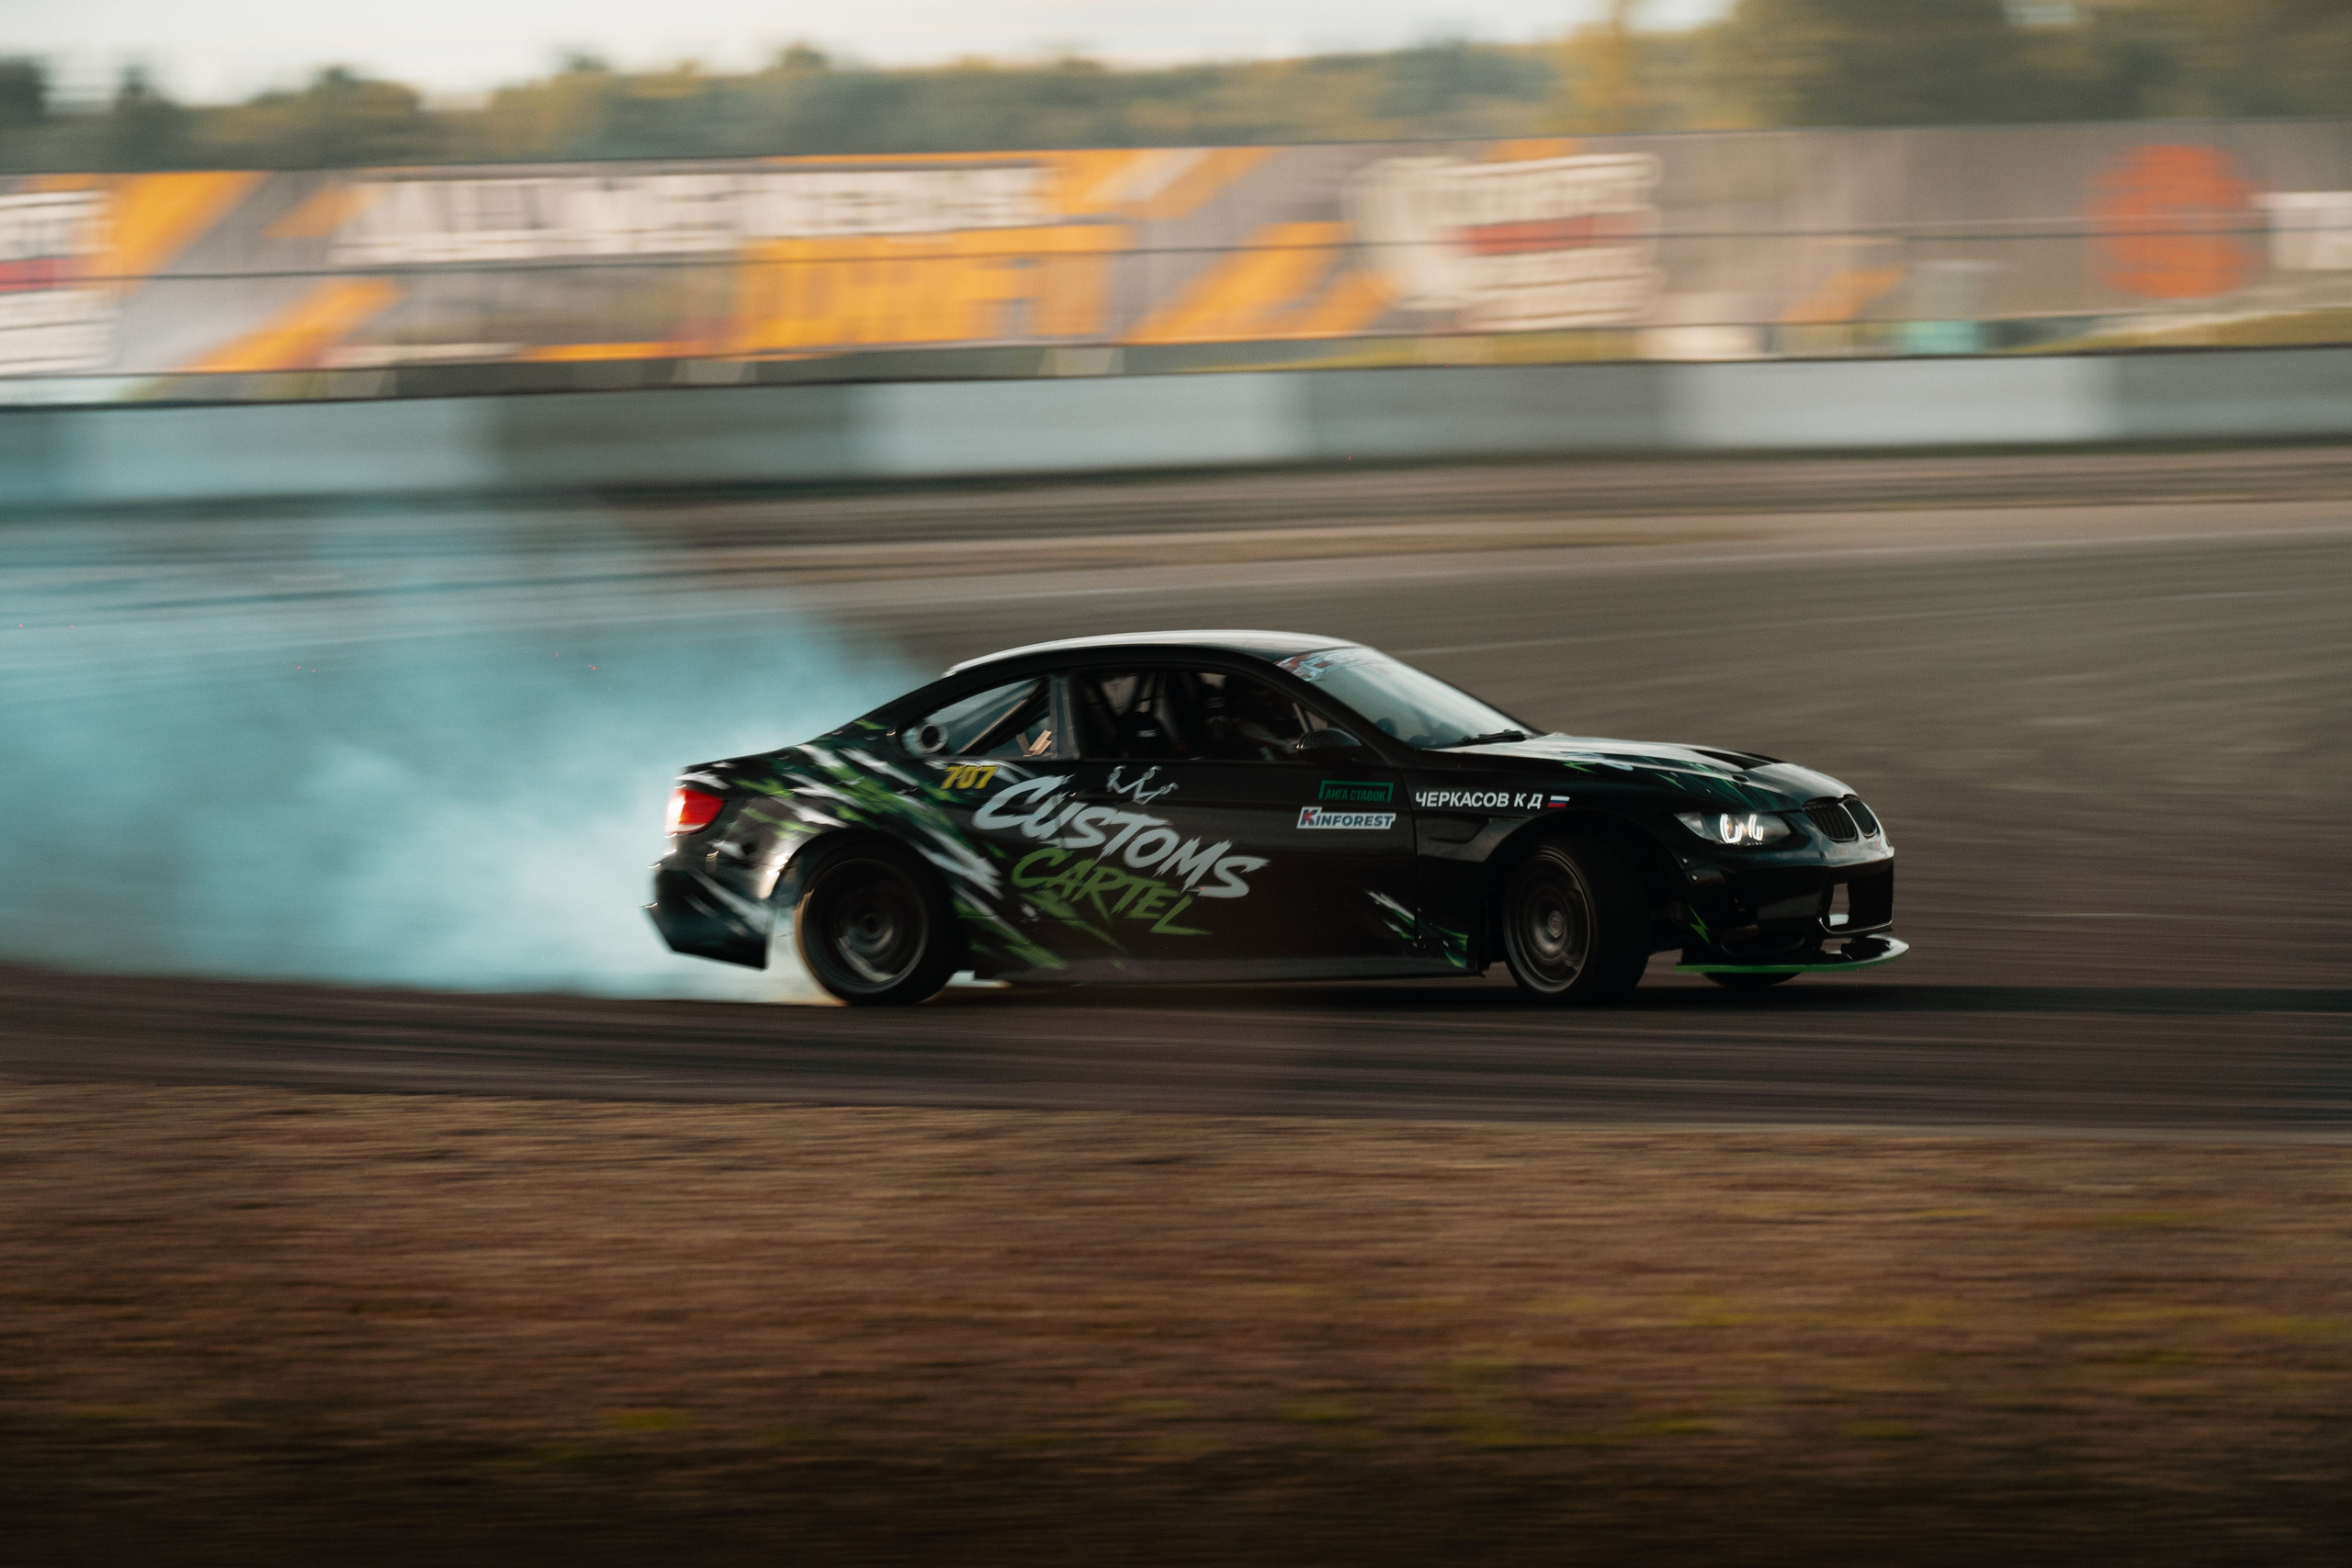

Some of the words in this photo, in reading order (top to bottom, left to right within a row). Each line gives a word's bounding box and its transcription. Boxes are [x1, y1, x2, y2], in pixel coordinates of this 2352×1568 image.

[941, 765, 998, 789] 707
[1324, 788, 1348, 801] ЛИГА
[1350, 790, 1385, 802] СТАВОК
[1415, 791, 1510, 807] ЧЕРКАСОВ
[1514, 793, 1525, 807] К
[1526, 794, 1544, 809] Д
[1300, 809, 1394, 827] KINFOREST
[972, 773, 1271, 898] CUSTOMS
[1012, 847, 1213, 935] CARTEL
